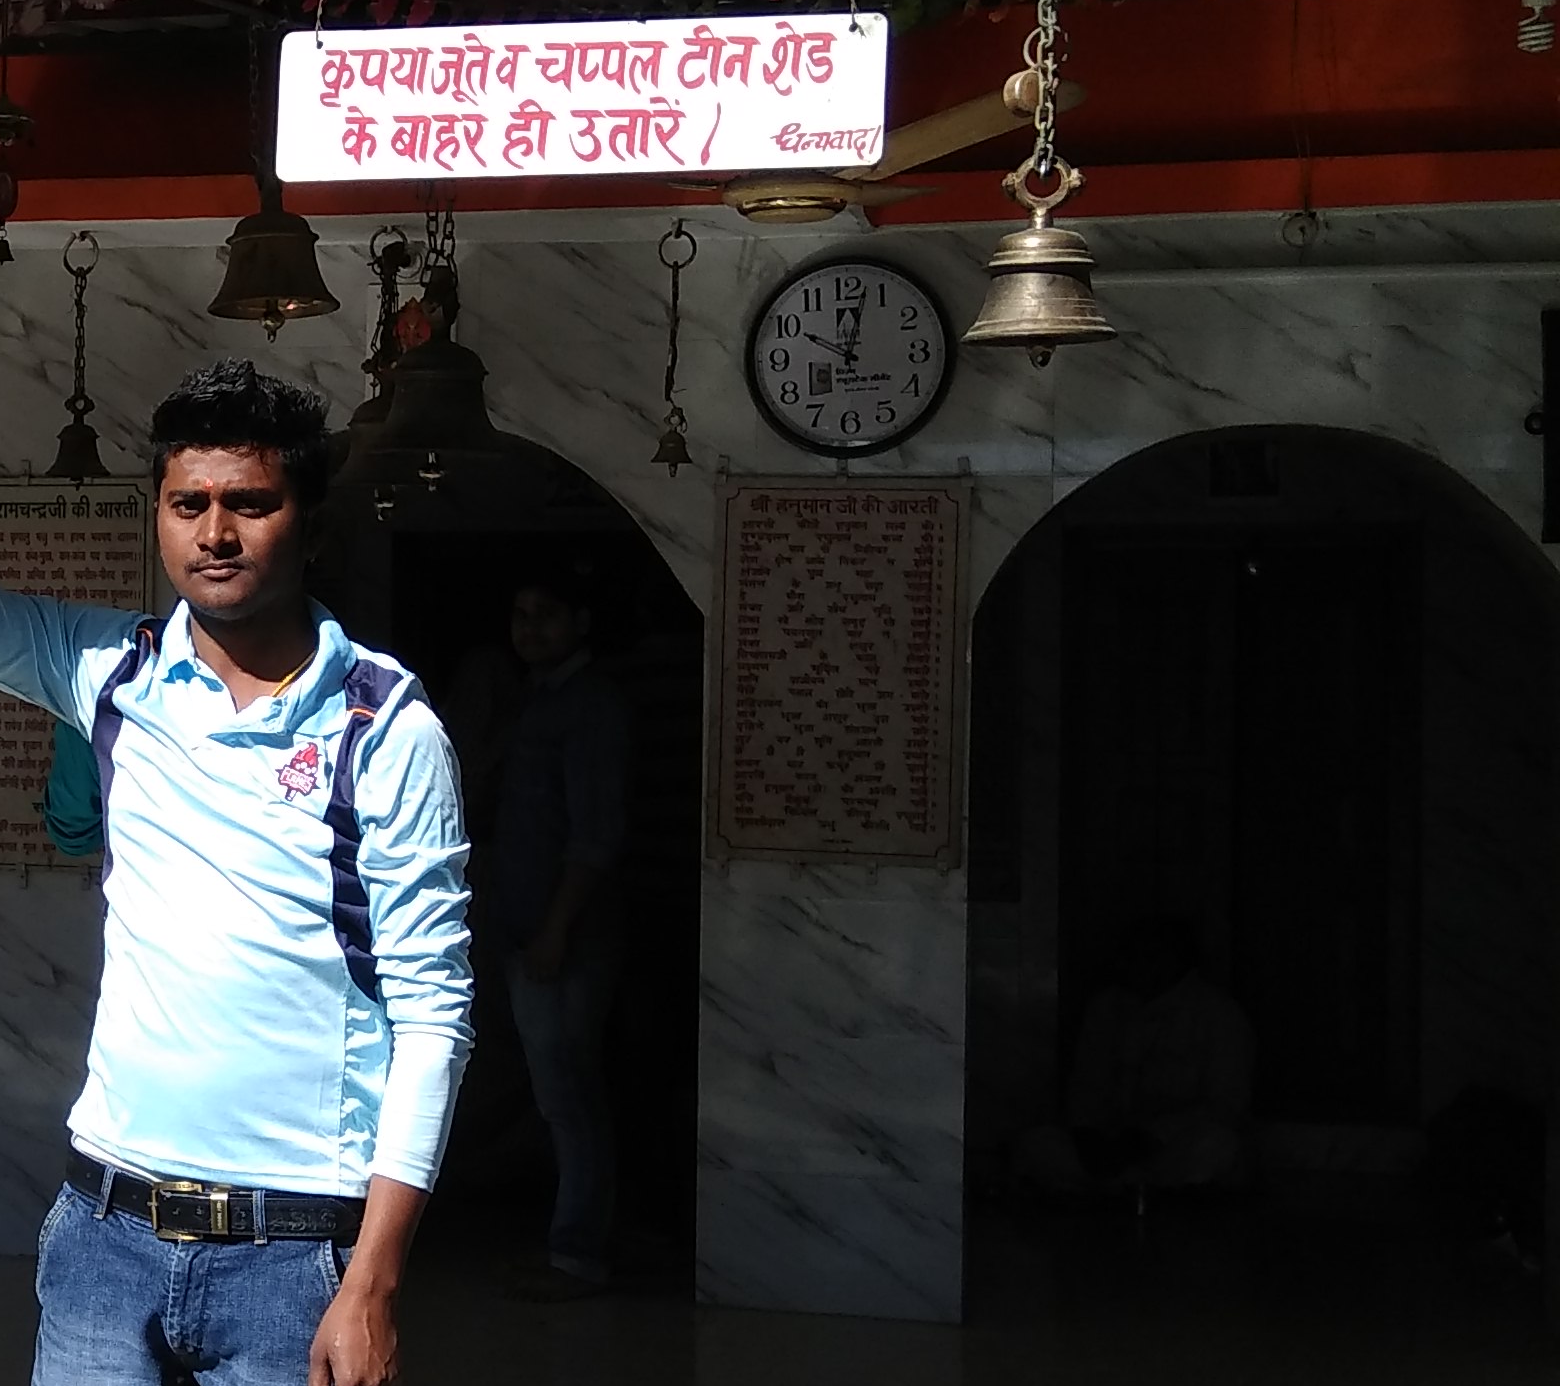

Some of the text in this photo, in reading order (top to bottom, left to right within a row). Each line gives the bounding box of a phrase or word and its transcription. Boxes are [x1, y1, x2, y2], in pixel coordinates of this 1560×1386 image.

[319, 21, 838, 108] कृपया जूते व चप्पल टीन शेड
[342, 106, 379, 165] के
[391, 115, 489, 172] बाहर
[502, 99, 557, 169] ही
[569, 97, 686, 165] उतारें
[802, 287, 823, 312] 11
[834, 276, 862, 301] 12
[878, 283, 886, 307] 1
[776, 313, 801, 339] 10
[900, 306, 918, 330] 2
[769, 348, 790, 372] 9
[908, 339, 931, 363] 3
[780, 381, 800, 405] 8
[900, 373, 920, 397] 4
[805, 403, 825, 428] 7
[840, 411, 861, 435] 6
[875, 400, 896, 424] 5
[71, 495, 90, 519] की
[94, 495, 138, 519] आरती
[751, 494, 939, 519] श्री हनुमान जी की आरती
